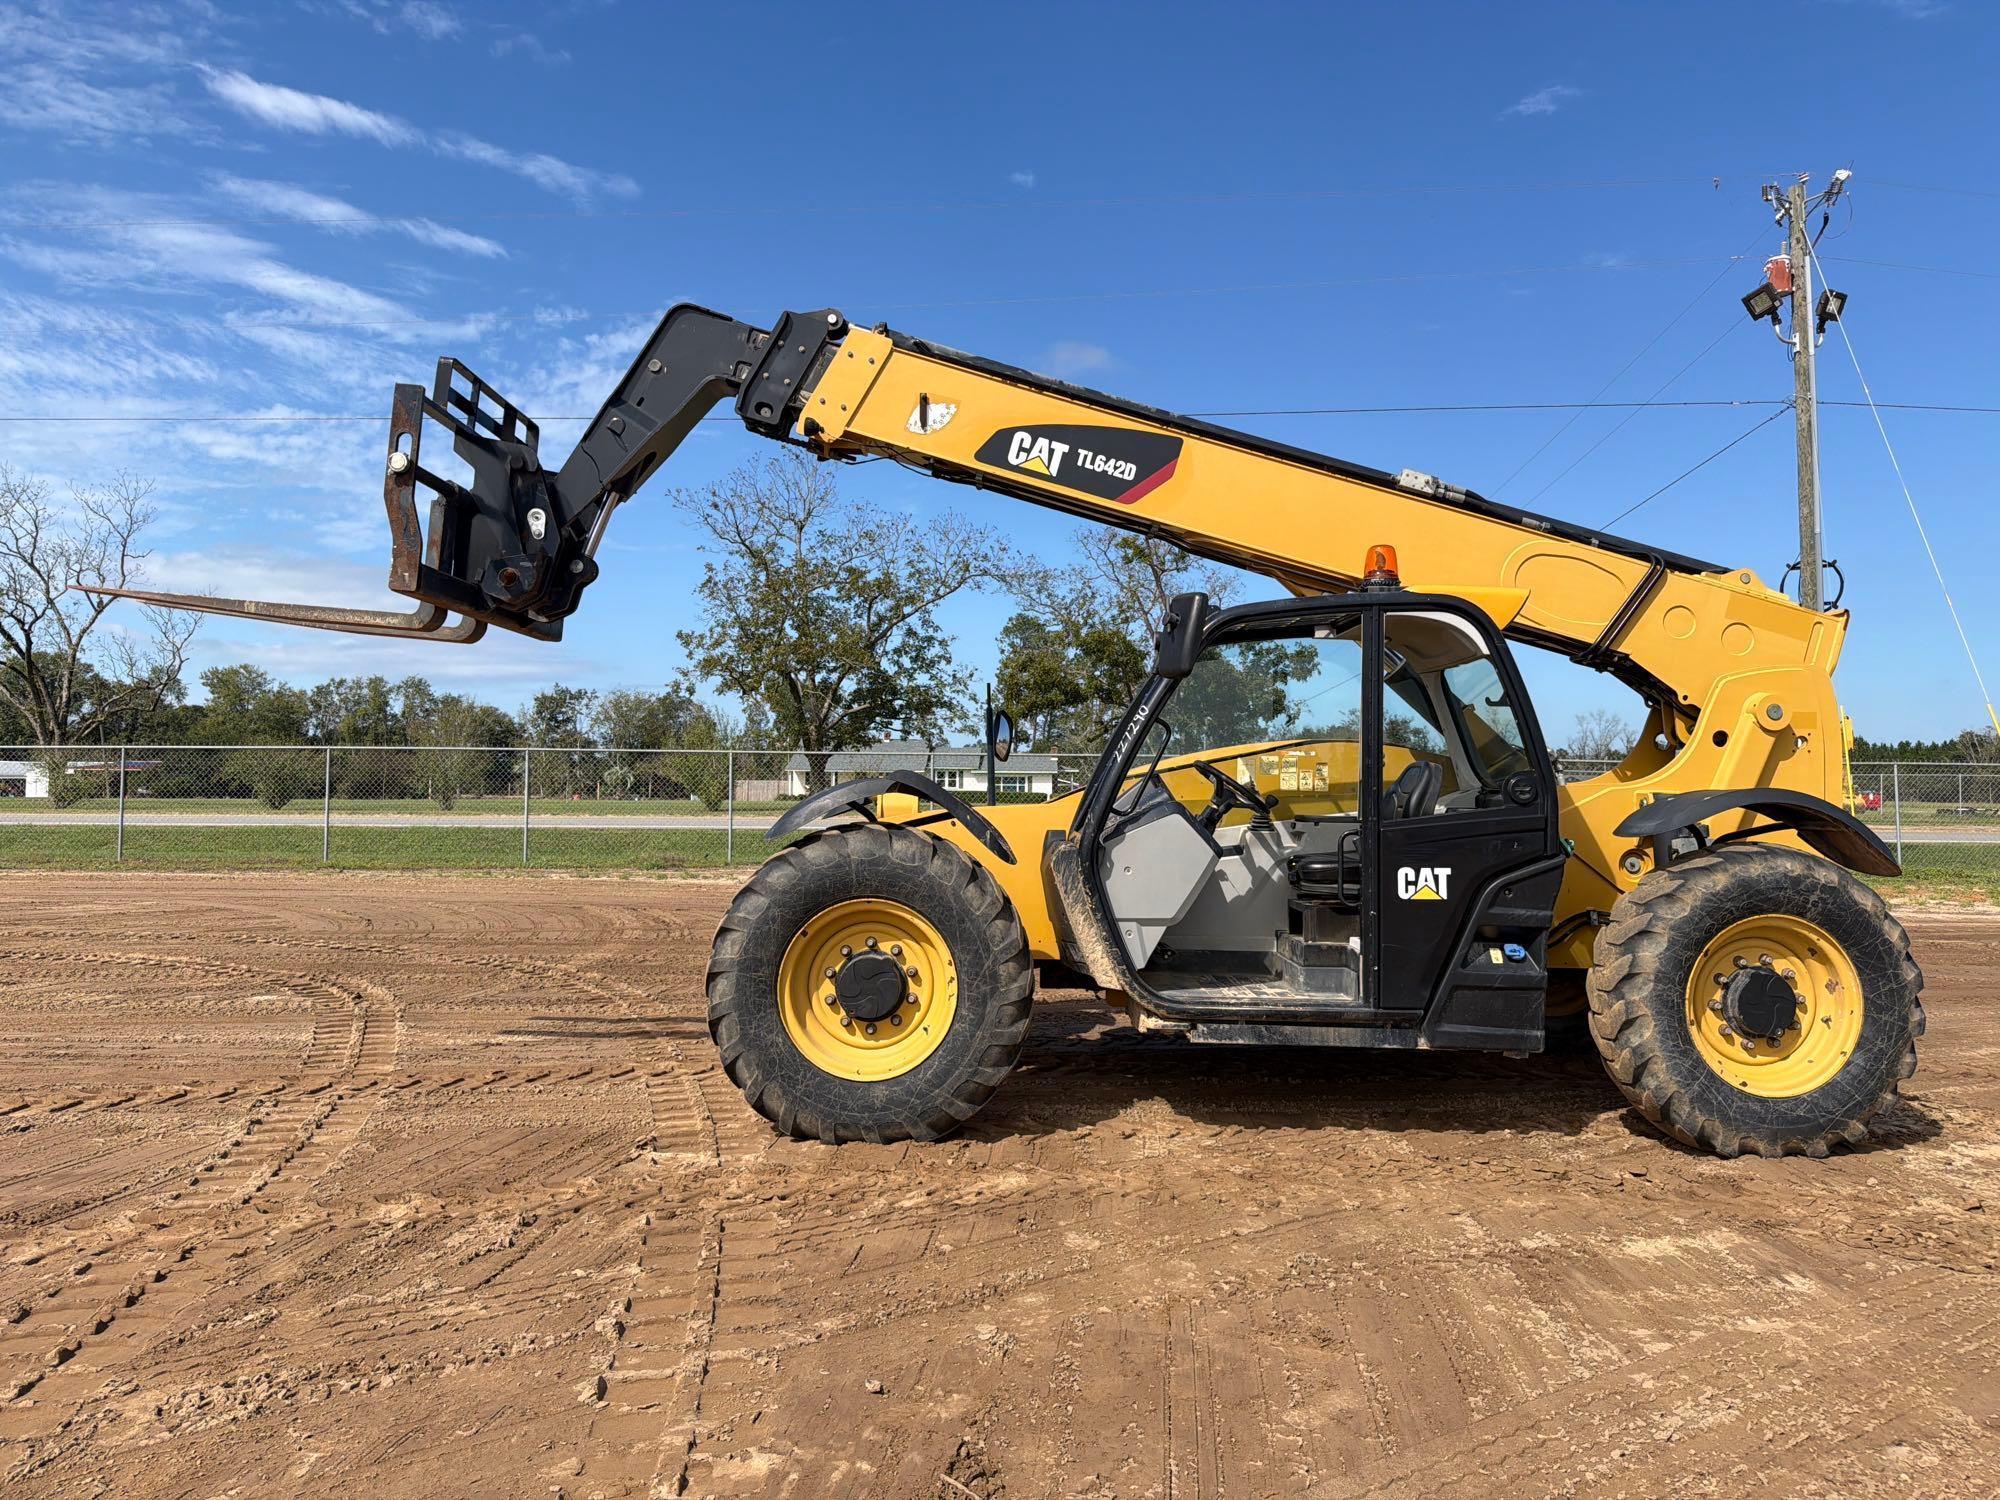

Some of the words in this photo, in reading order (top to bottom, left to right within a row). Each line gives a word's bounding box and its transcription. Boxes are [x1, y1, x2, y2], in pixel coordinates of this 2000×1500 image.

[1007, 431, 1069, 477] CAT
[1076, 448, 1137, 481] TL642D
[1397, 866, 1452, 900] CAT
